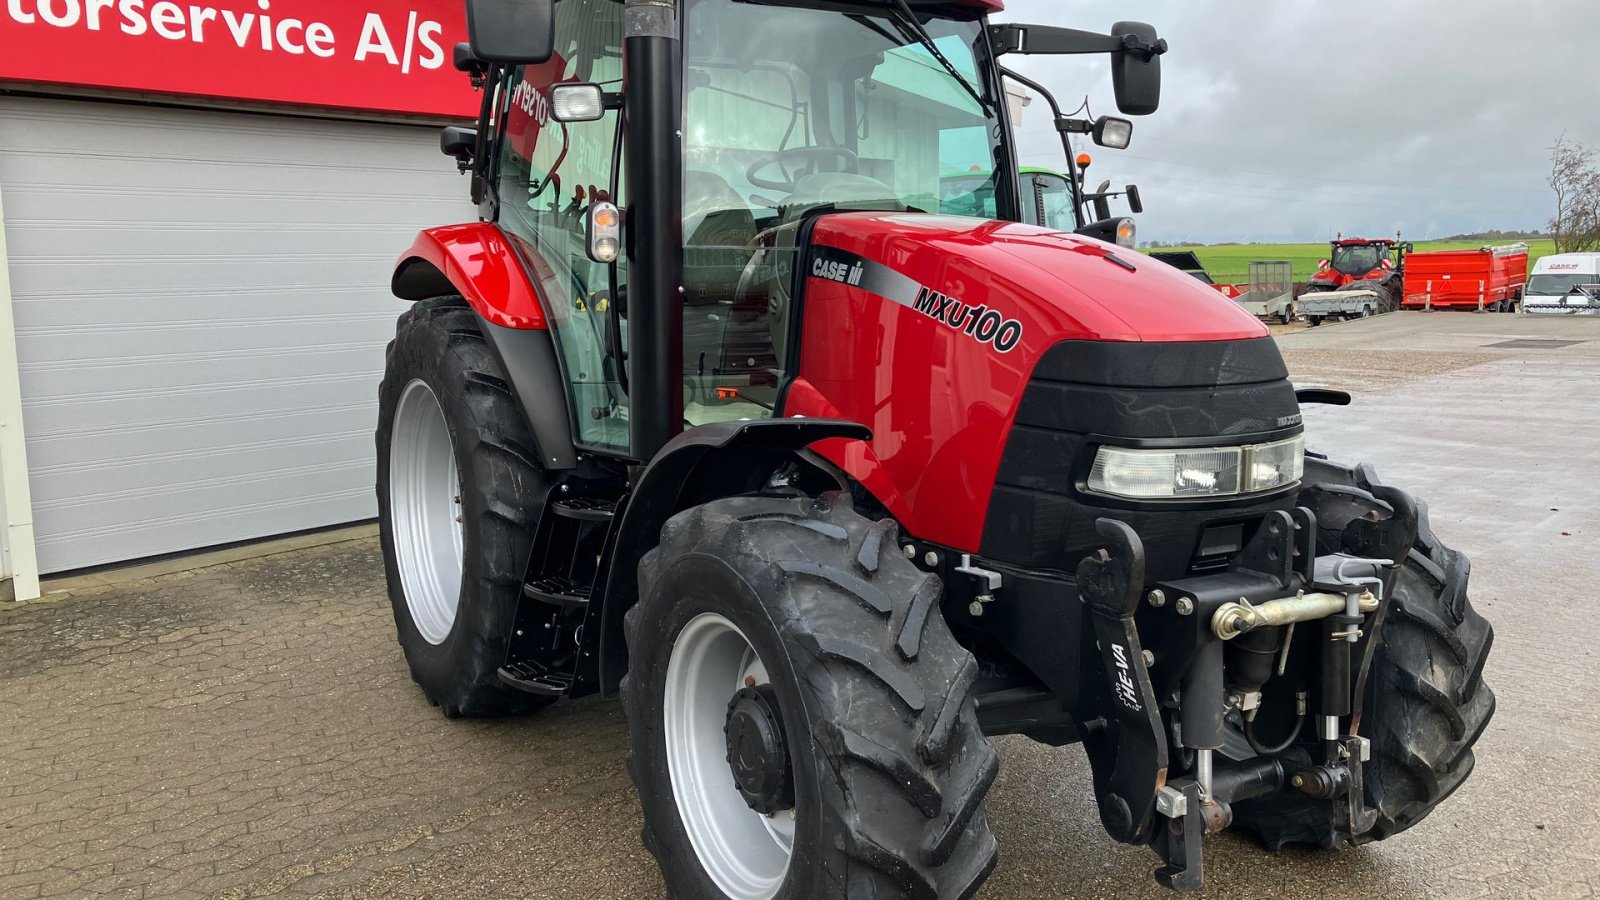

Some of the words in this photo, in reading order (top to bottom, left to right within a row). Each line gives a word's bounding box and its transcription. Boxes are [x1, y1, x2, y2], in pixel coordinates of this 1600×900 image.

[354, 10, 445, 74] A/S
[812, 257, 849, 282] CASE
[913, 286, 1023, 353] MXU100
[1111, 643, 1137, 703] HE-VA
